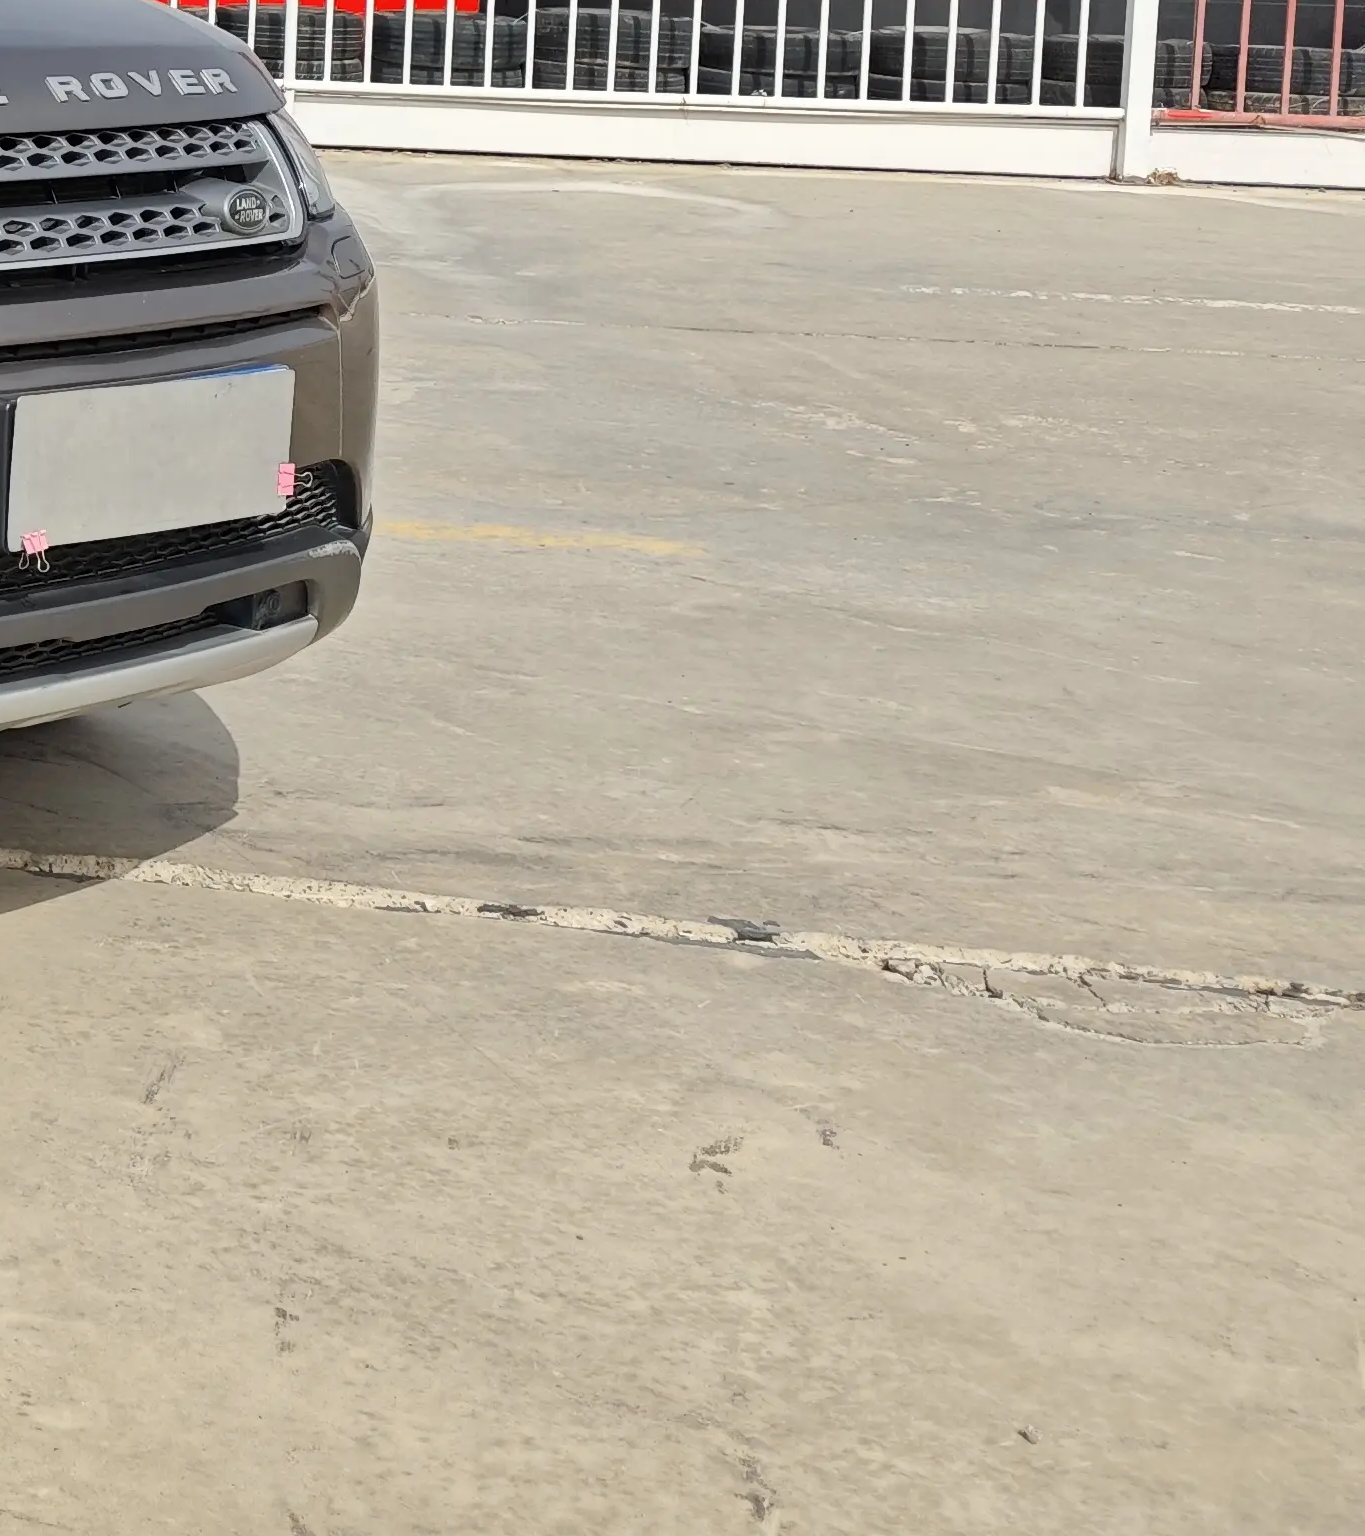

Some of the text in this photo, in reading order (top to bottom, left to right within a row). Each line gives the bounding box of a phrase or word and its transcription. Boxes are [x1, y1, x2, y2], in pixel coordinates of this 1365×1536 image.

[43, 67, 239, 103] ROVER
[236, 196, 257, 210] LAND
[239, 209, 264, 223] ROVER
